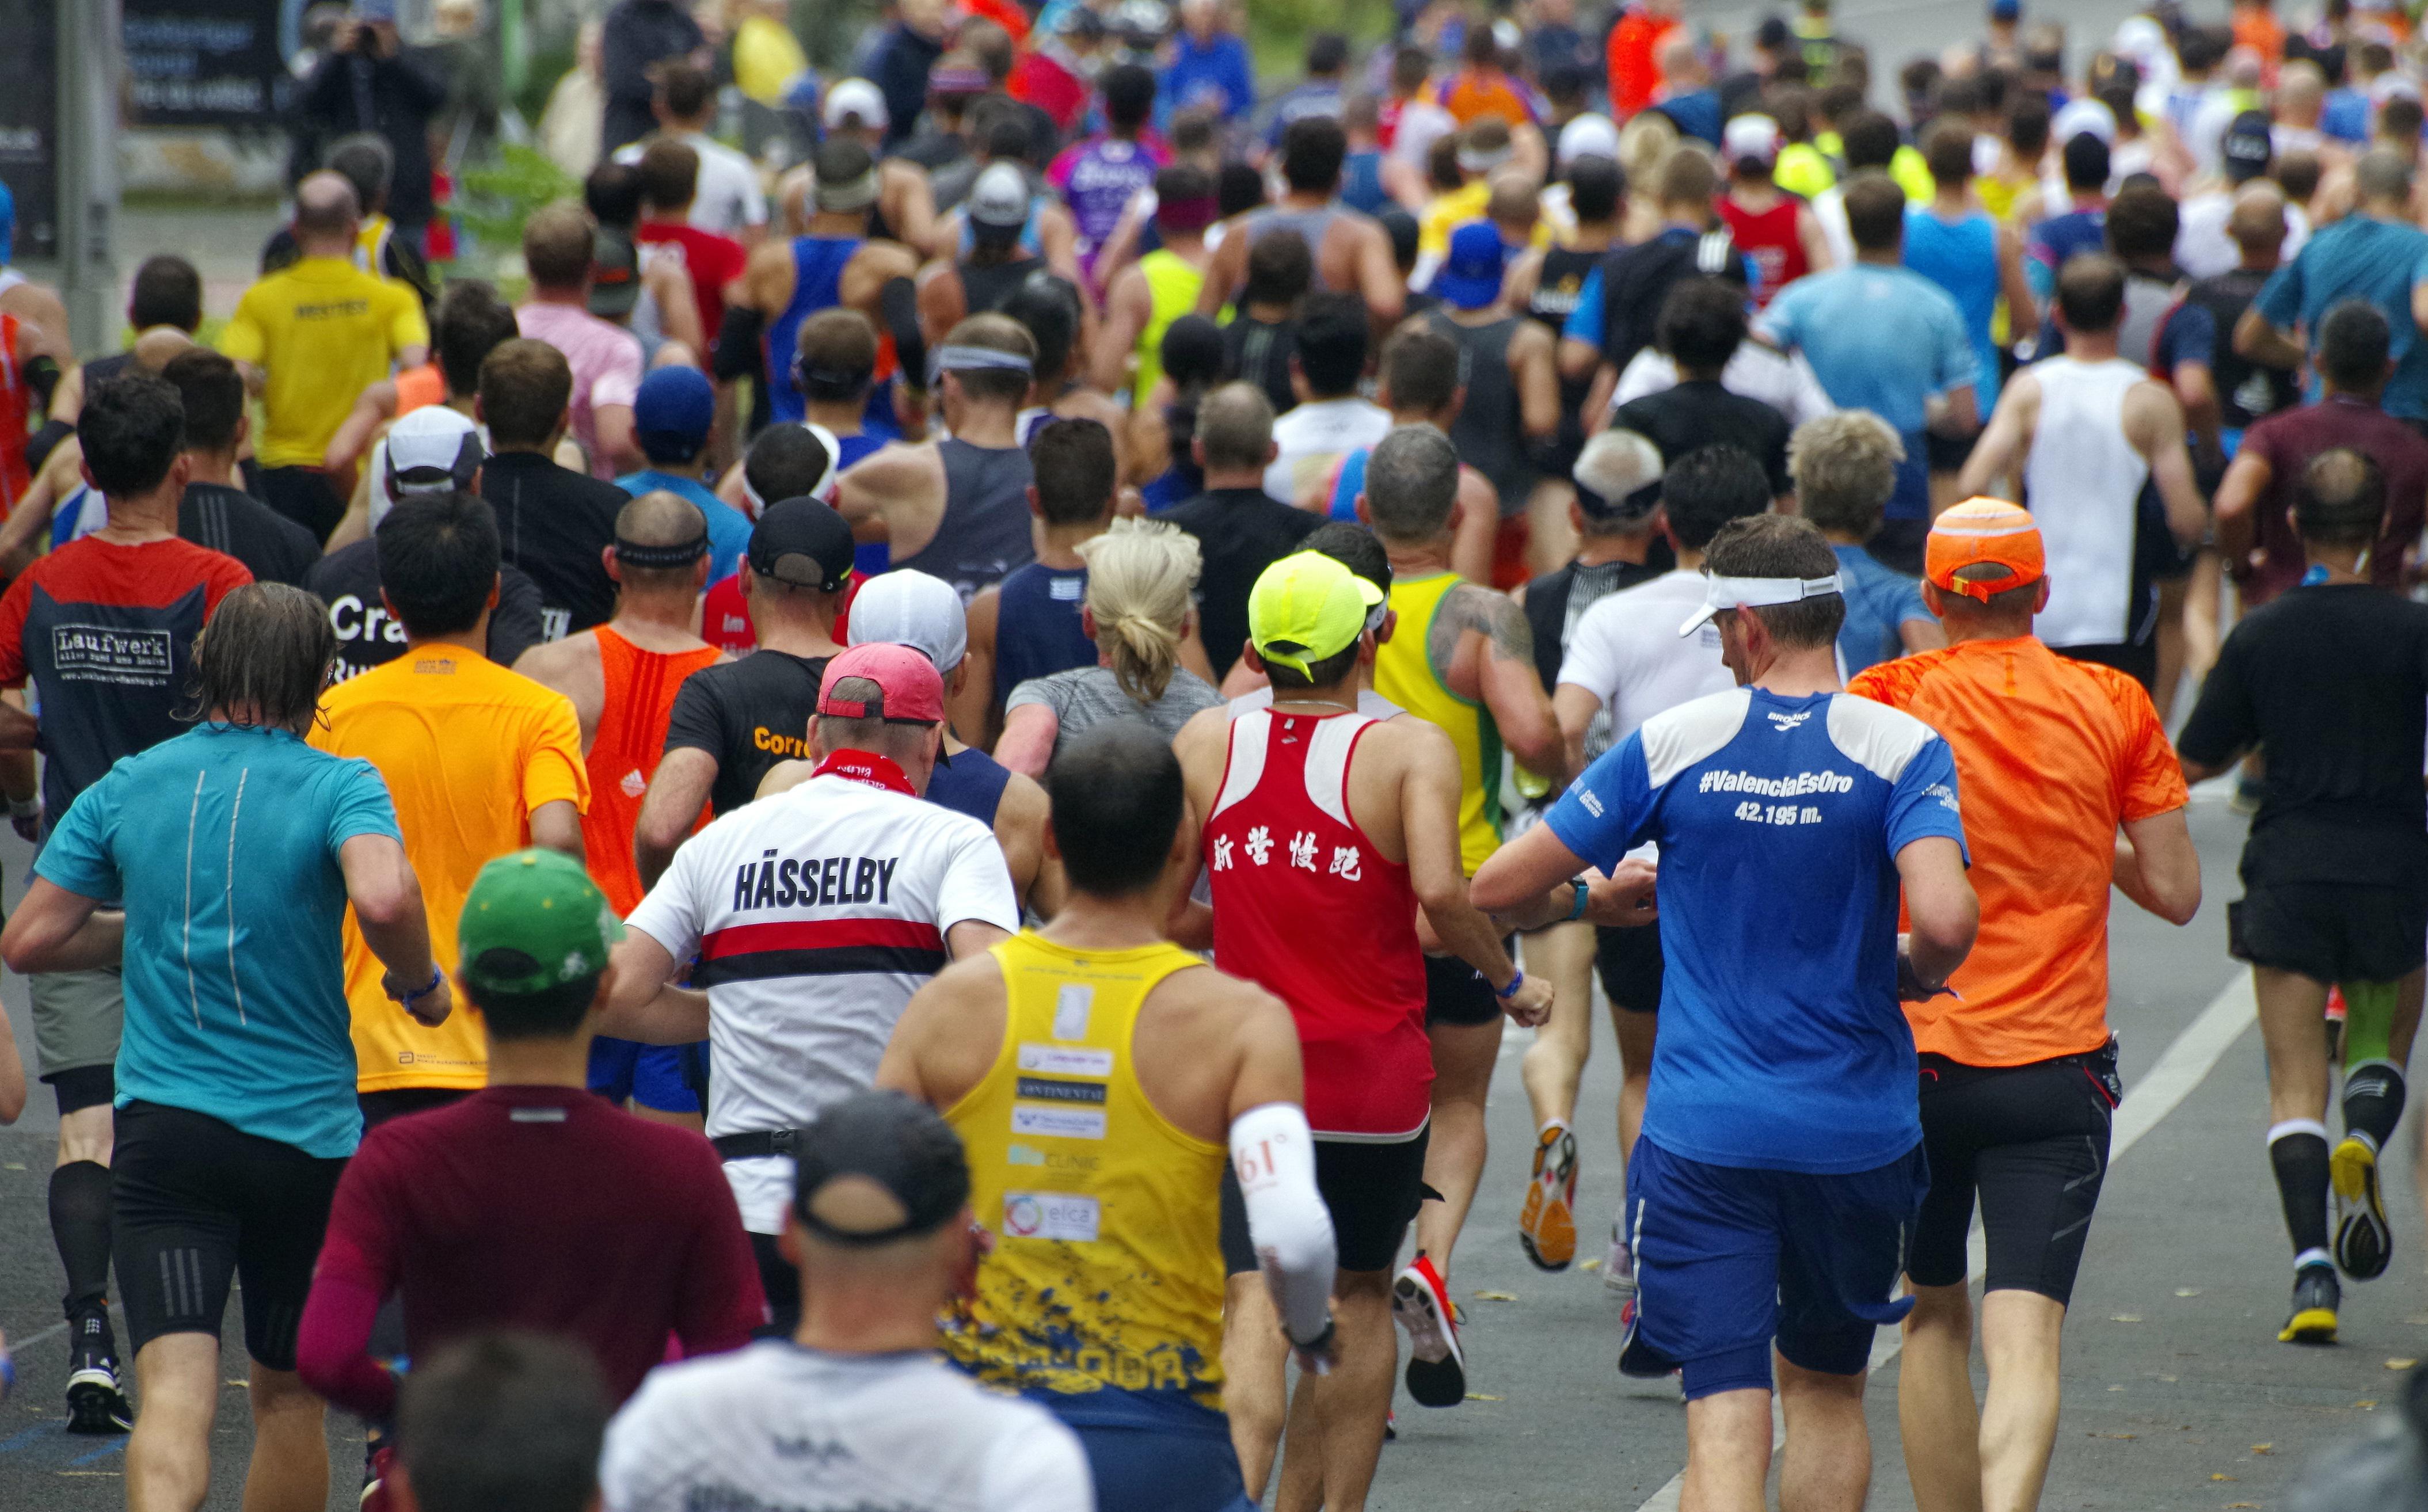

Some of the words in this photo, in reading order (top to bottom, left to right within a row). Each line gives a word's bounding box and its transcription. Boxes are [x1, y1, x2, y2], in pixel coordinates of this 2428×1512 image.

[59, 631, 165, 656] Laufwerk
[1767, 711, 1812, 722] BROOKS
[1699, 770, 1854, 798] #ValenciaEsOro
[1734, 801, 1798, 826] 42.195
[1800, 807, 1822, 825] m.
[733, 848, 900, 912] HÄSSELBY
